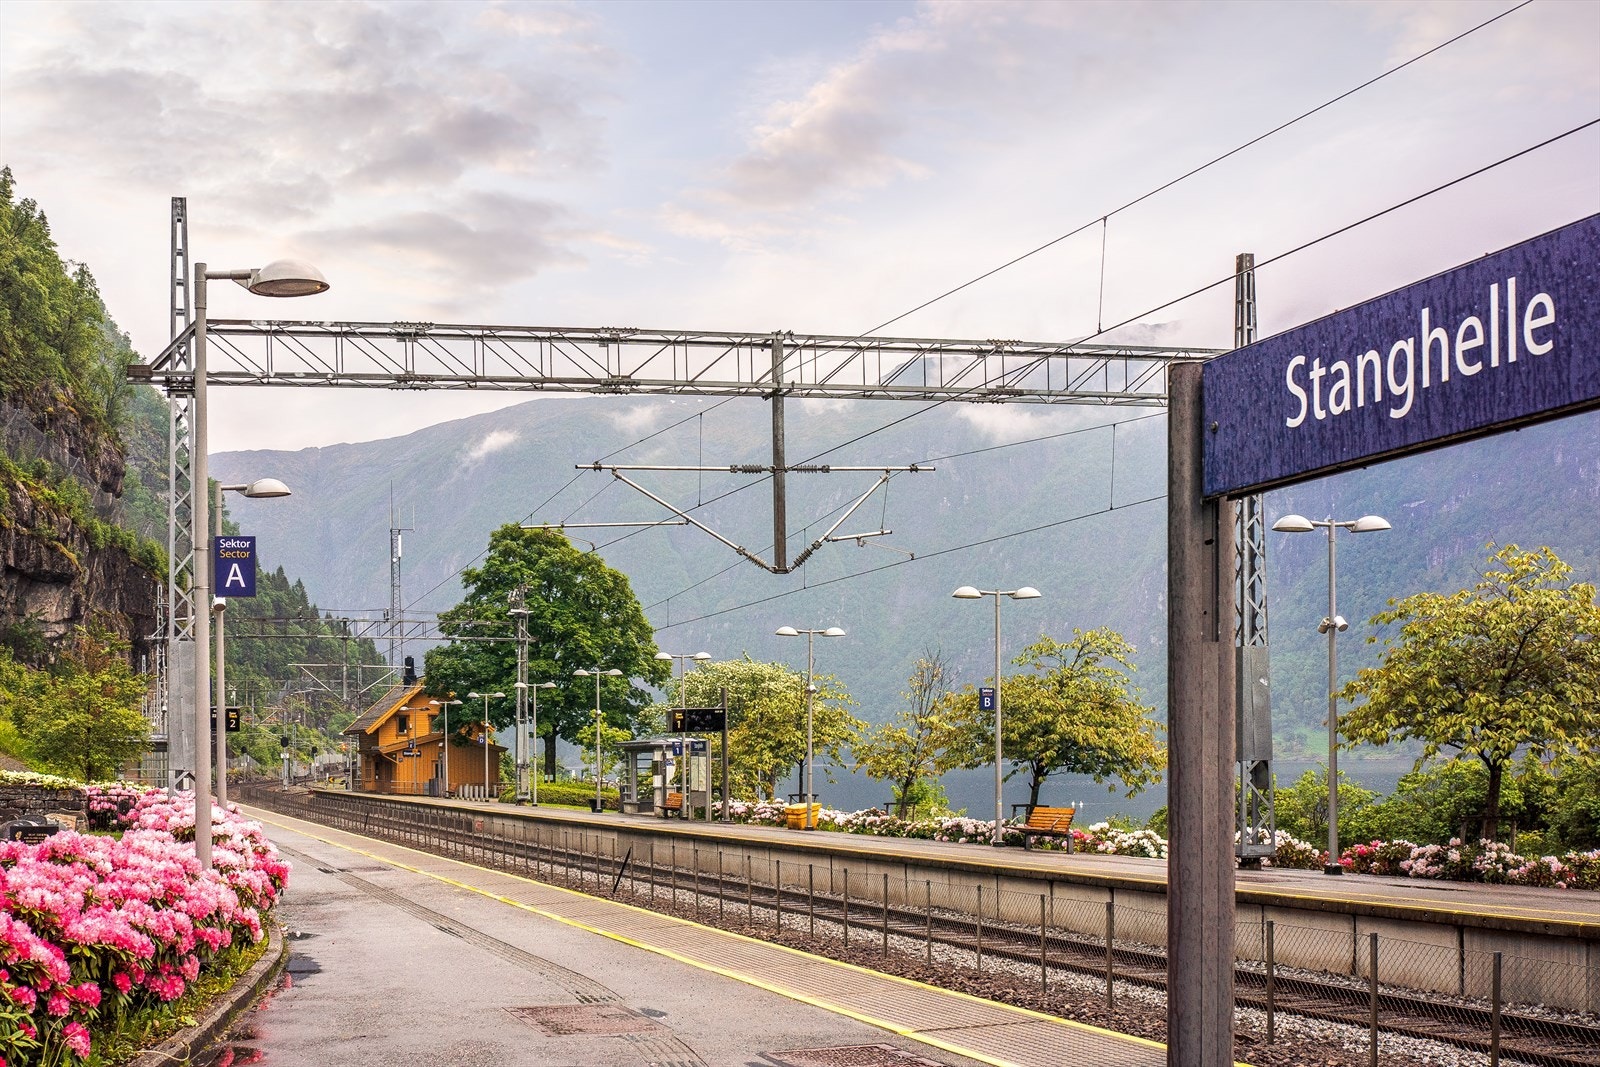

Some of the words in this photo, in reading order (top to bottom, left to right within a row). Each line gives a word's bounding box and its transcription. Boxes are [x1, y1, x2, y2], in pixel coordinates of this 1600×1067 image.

[1285, 276, 1556, 428] Stanghelle
[219, 538, 251, 549] Sektor
[219, 548, 251, 559] Sector
[225, 563, 246, 588] A
[984, 697, 990, 706] B
[230, 720, 236, 728] 2
[676, 720, 680, 728] 1
